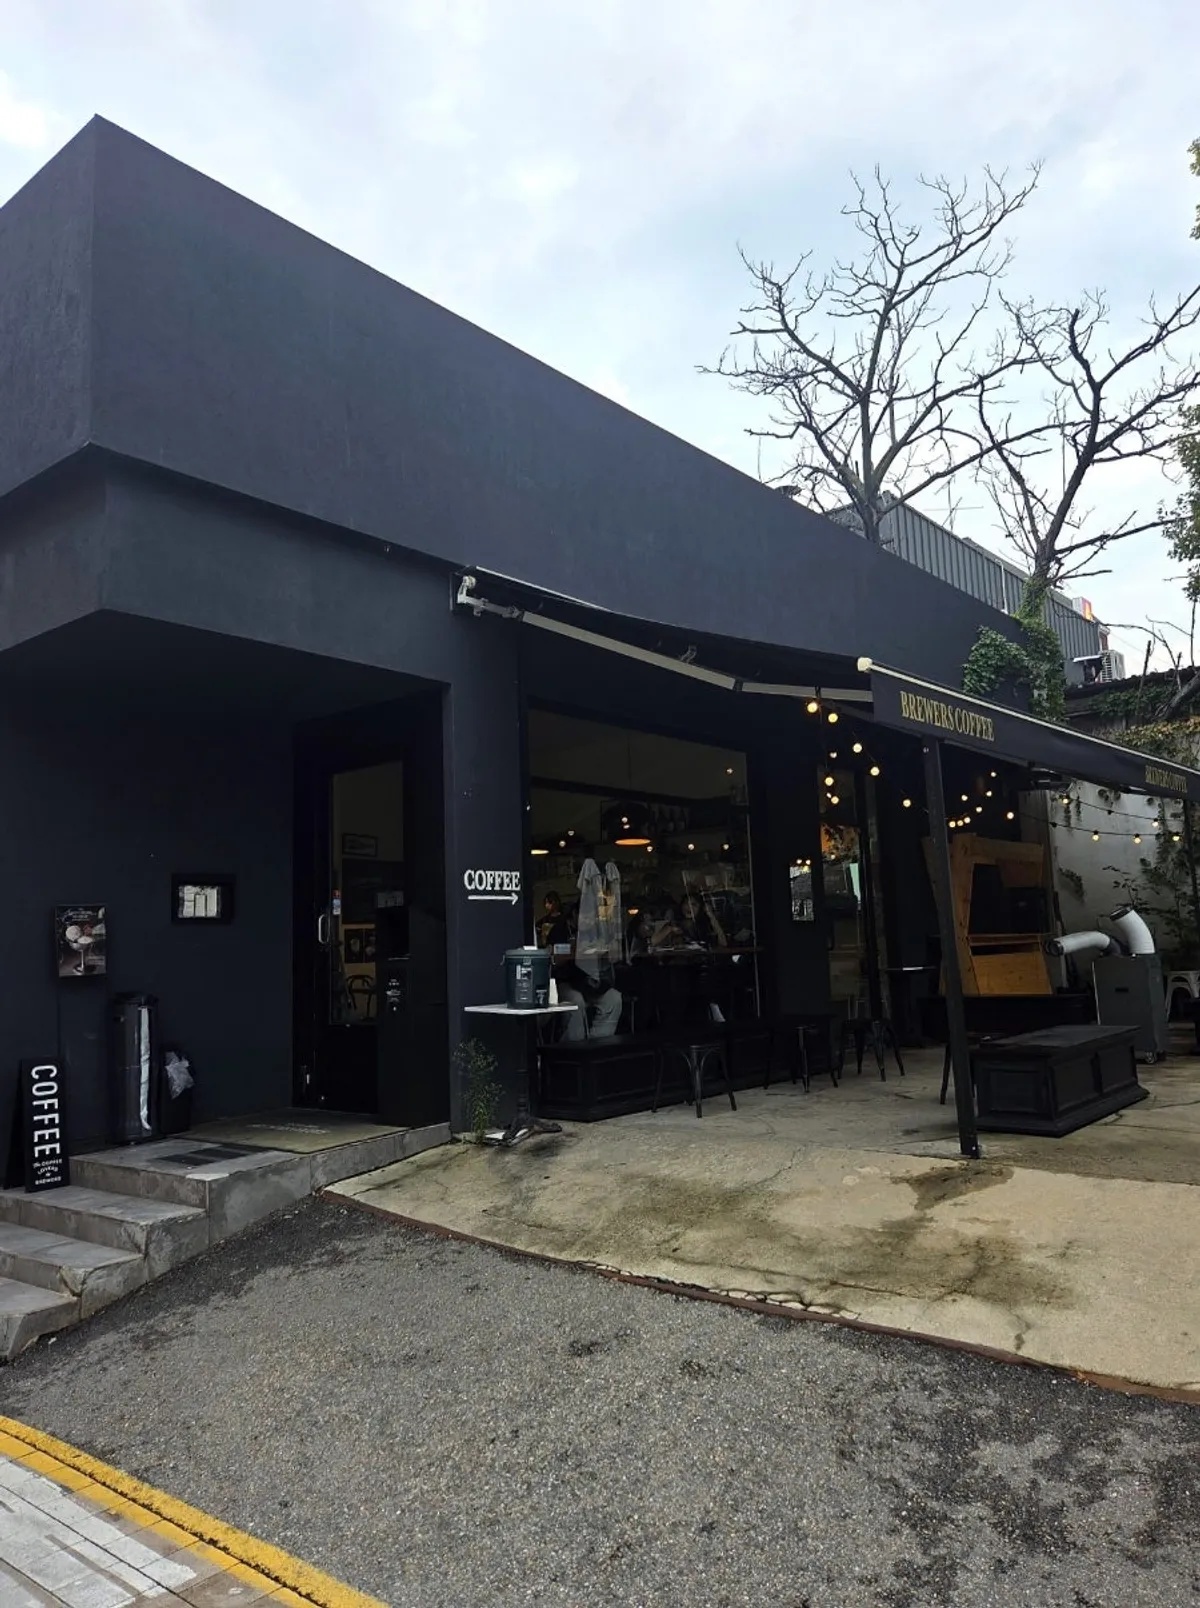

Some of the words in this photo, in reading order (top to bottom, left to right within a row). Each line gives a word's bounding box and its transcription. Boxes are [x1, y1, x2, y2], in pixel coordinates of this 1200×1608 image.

[900, 690, 955, 731] BREWERS
[954, 707, 995, 742] COFFEE
[463, 869, 521, 891] COFFEE
[31, 1065, 60, 1158] COFFEE
